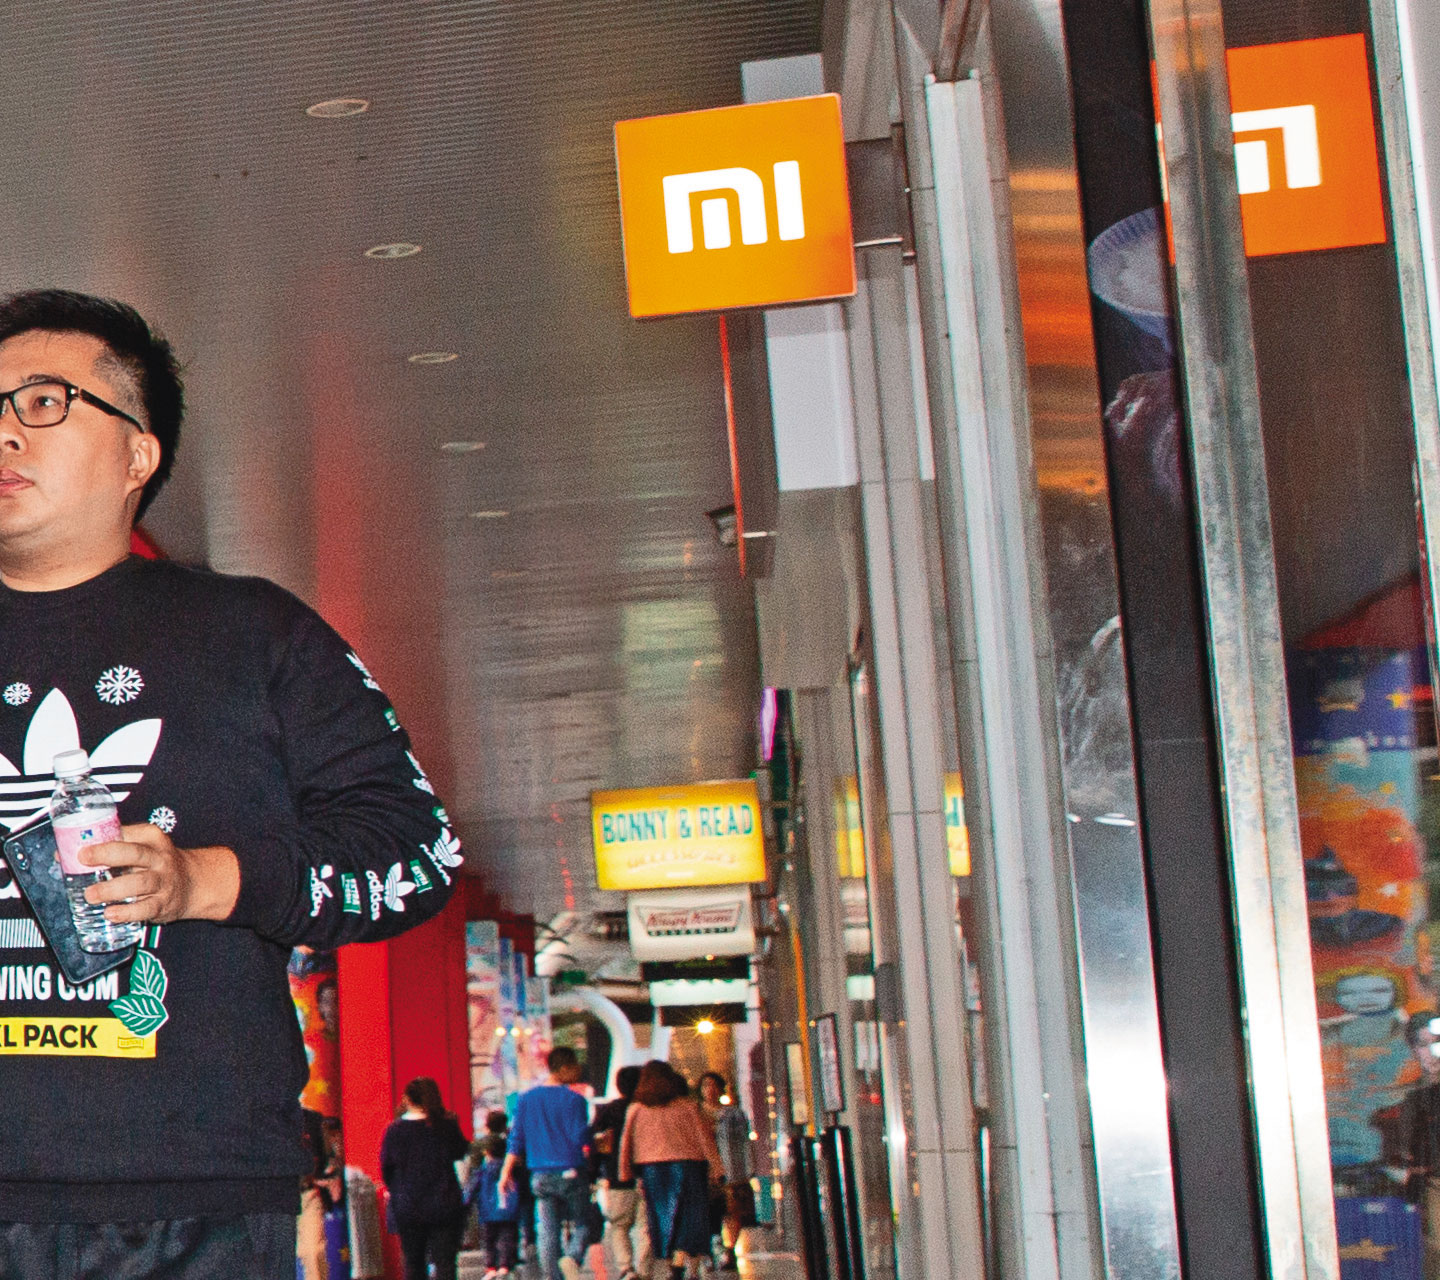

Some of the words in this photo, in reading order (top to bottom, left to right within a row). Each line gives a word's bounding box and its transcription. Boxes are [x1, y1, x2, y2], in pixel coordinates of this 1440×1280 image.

[601, 810, 669, 844] BONNY
[698, 804, 754, 837] READ
[24, 1024, 99, 1049] PACK
